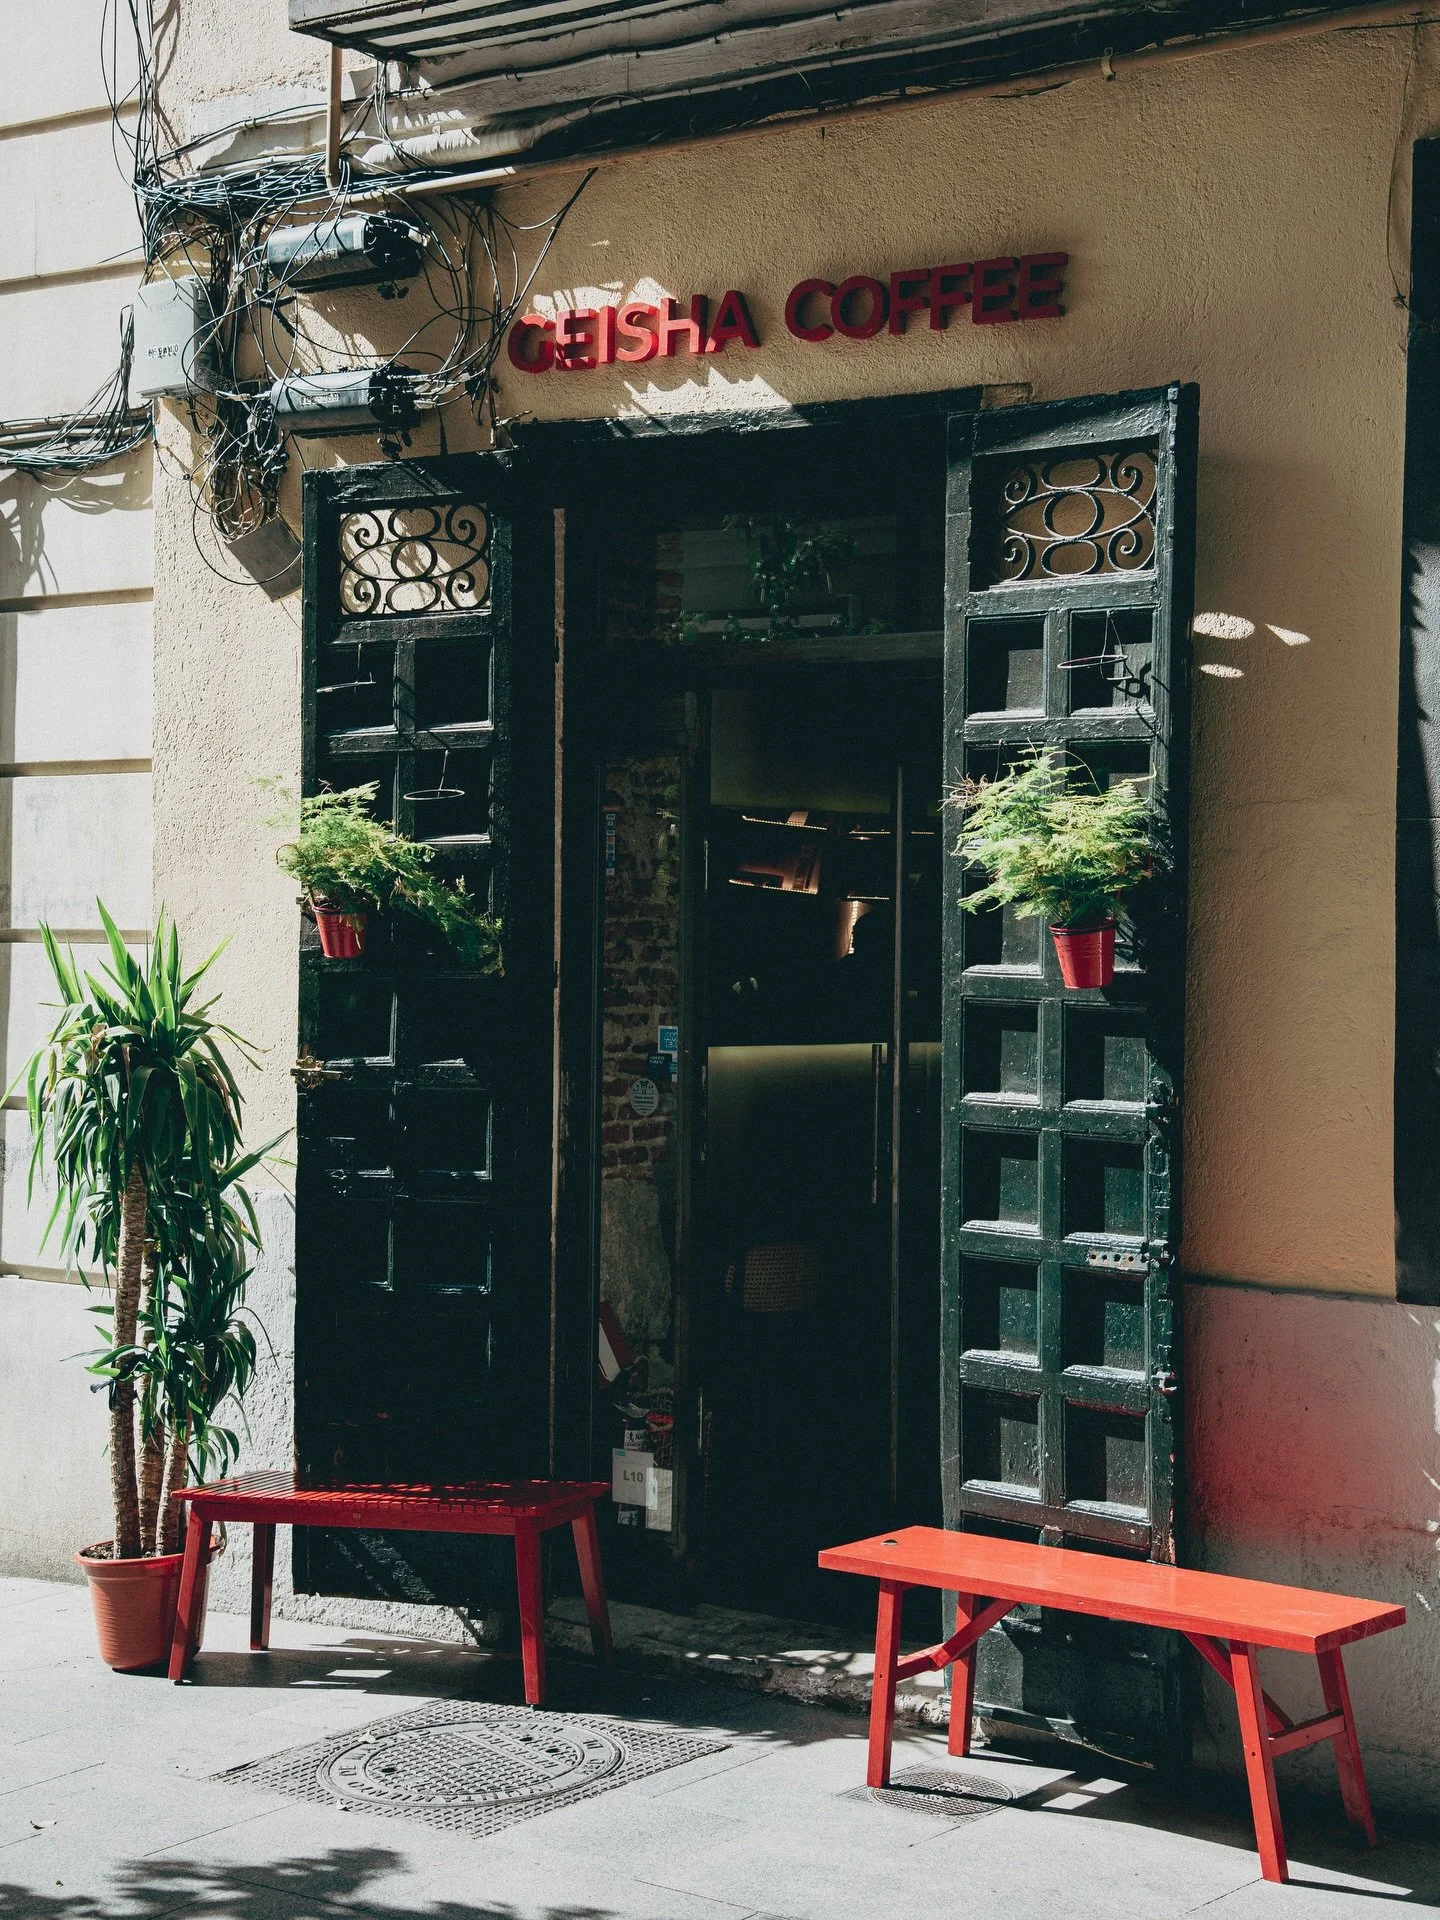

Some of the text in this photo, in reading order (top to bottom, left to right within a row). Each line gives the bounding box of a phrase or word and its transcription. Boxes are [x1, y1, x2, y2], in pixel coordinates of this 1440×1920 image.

[507, 250, 1071, 374] GEISHA COFFEE
[623, 1470, 644, 1483] L10
